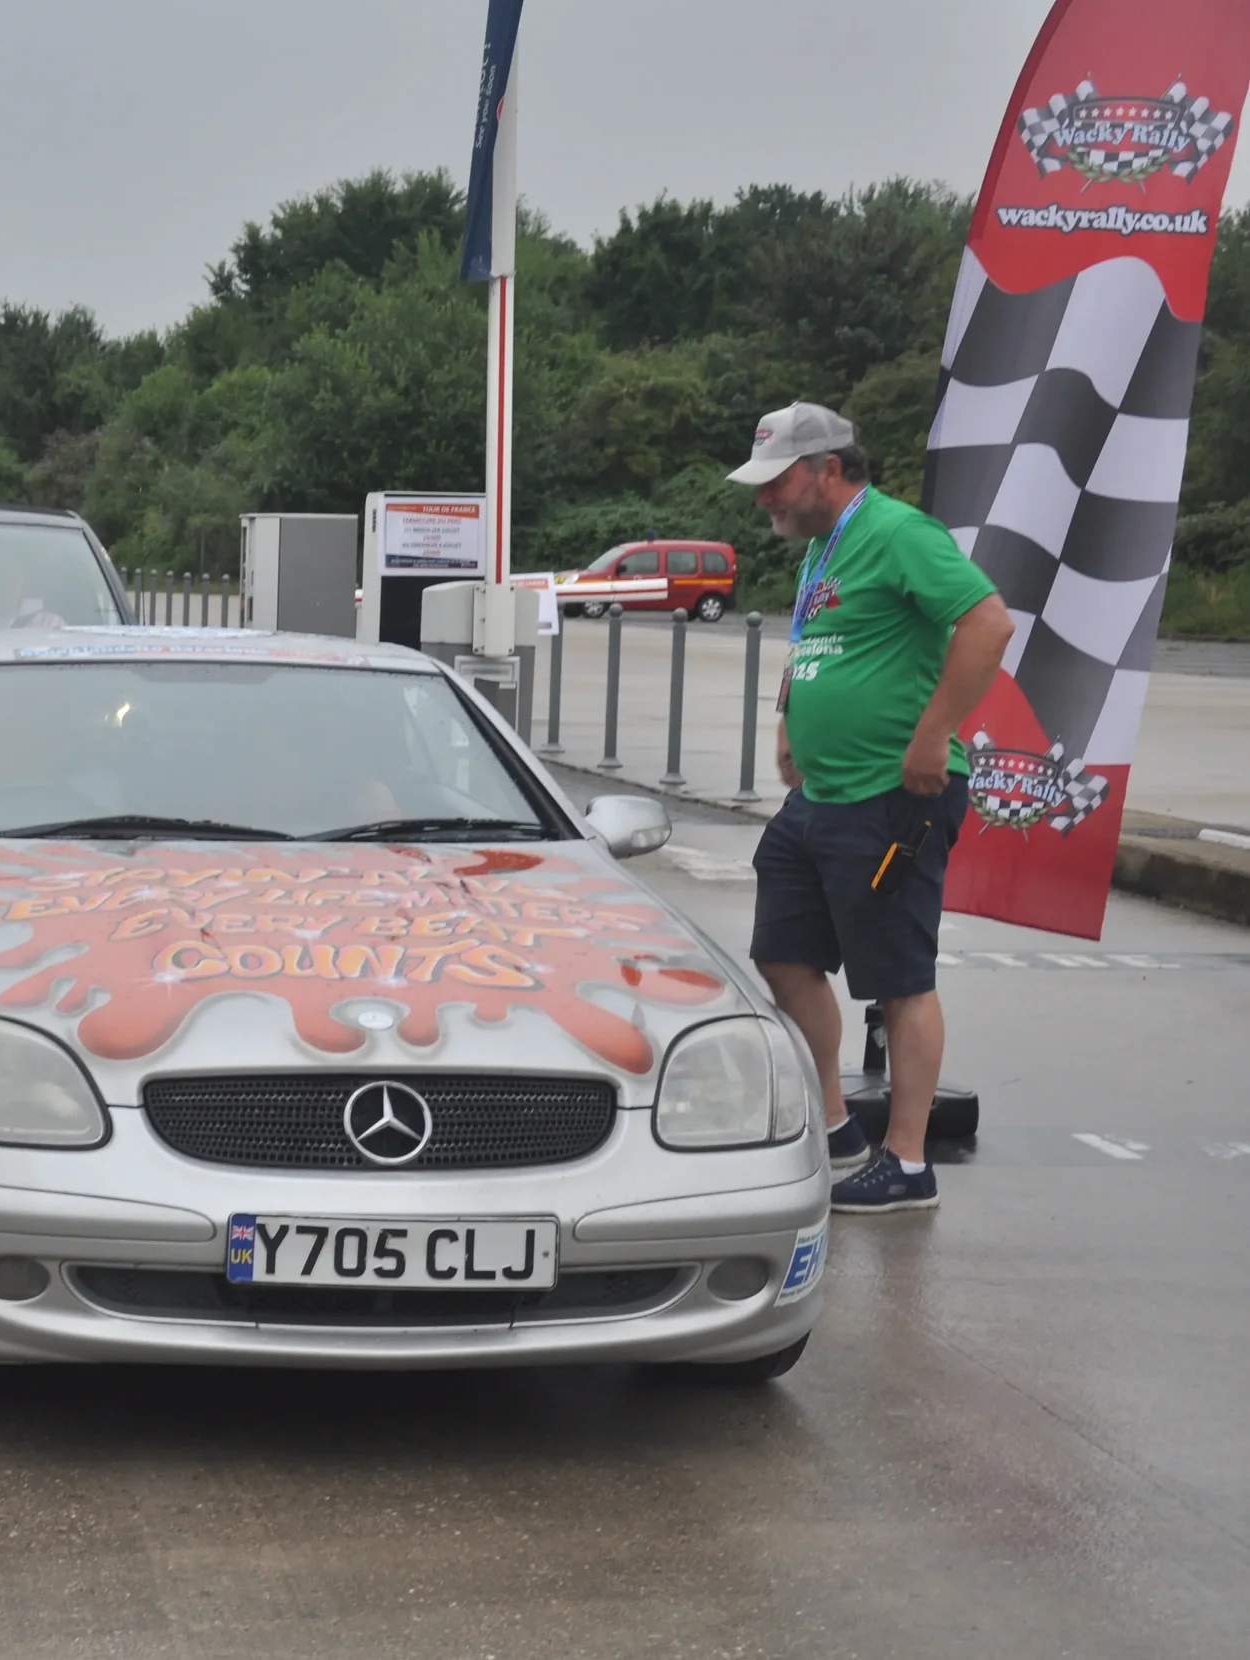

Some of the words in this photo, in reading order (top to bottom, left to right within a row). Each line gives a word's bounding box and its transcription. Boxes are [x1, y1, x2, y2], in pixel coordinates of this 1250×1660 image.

[1052, 122, 1128, 148] Wacky
[1130, 122, 1192, 154] Rally
[997, 203, 1209, 235] wackyrally.co.uk
[1020, 775, 1068, 808] Rally
[2, 884, 249, 920] EVERY
[256, 888, 400, 907] LIFE
[107, 906, 345, 942] EVERY
[354, 910, 592, 947] BEAT
[152, 938, 547, 991] COUNTS
[231, 1247, 253, 1264] UK
[256, 1223, 408, 1279] Y705
[425, 1228, 536, 1281] CLJ
